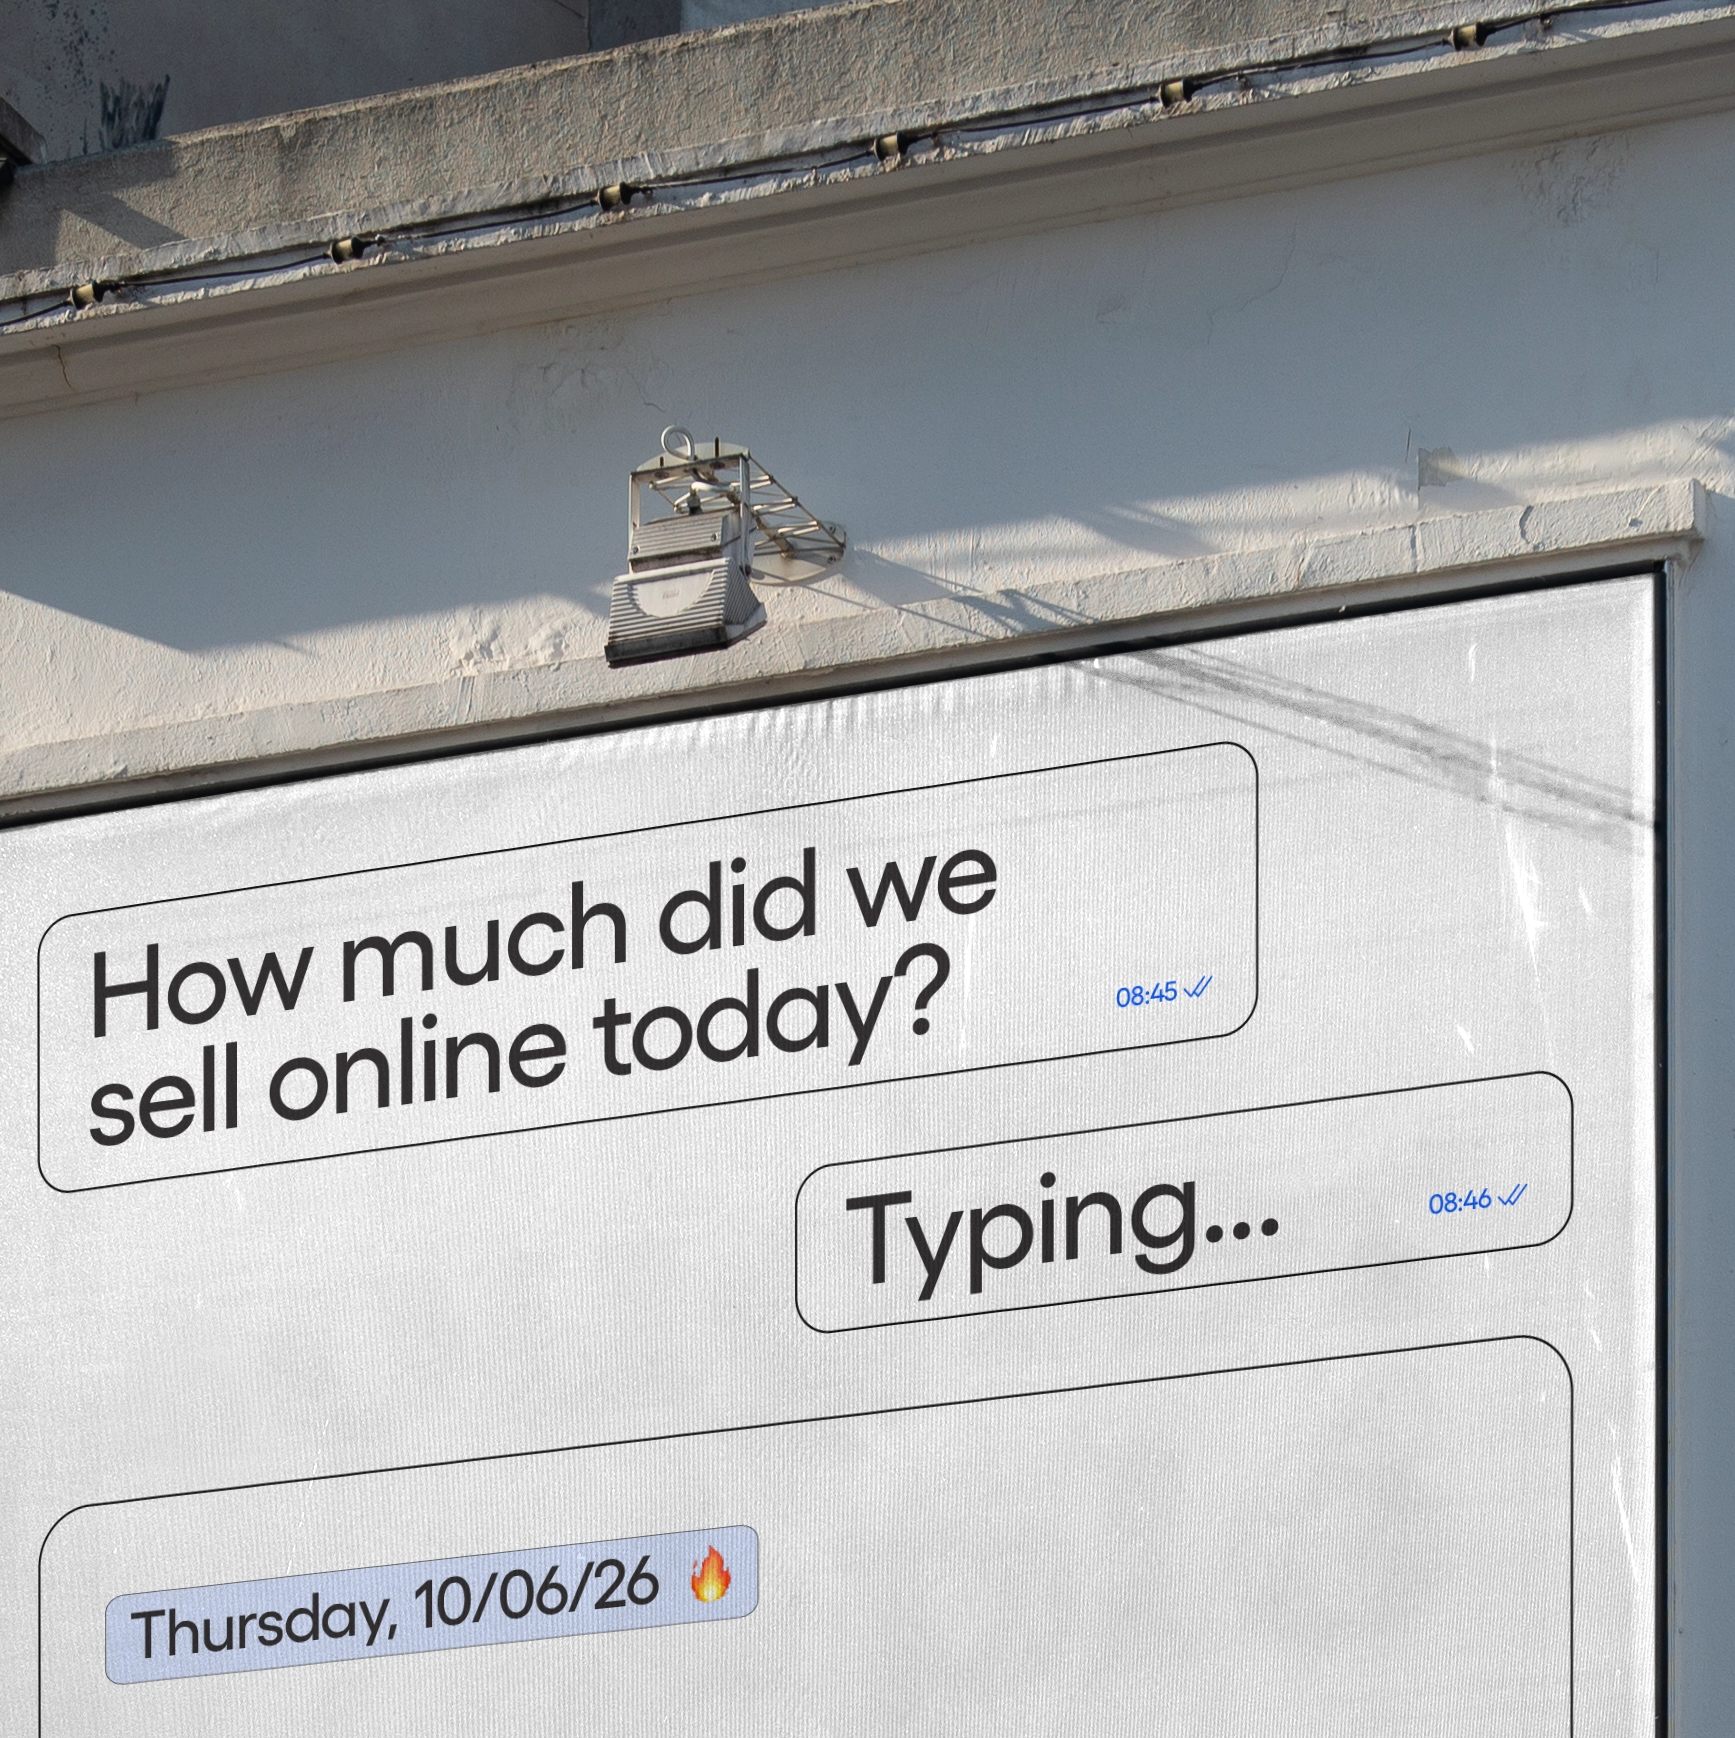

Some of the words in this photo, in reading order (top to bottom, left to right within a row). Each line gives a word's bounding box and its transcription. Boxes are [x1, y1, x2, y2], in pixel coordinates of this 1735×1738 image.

[92, 941, 316, 1040] How
[341, 879, 628, 1004] much
[657, 845, 817, 956] did
[844, 847, 999, 929] we
[1115, 979, 1179, 1009] 08:45
[88, 1040, 239, 1148] sell
[268, 1011, 568, 1123] online
[591, 941, 952, 1077] today?
[844, 1170, 1280, 1303] Typing...
[1427, 1186, 1494, 1216] 08:46
[129, 1591, 398, 1660] Thursday,
[414, 1554, 661, 1630] 10/06/26
